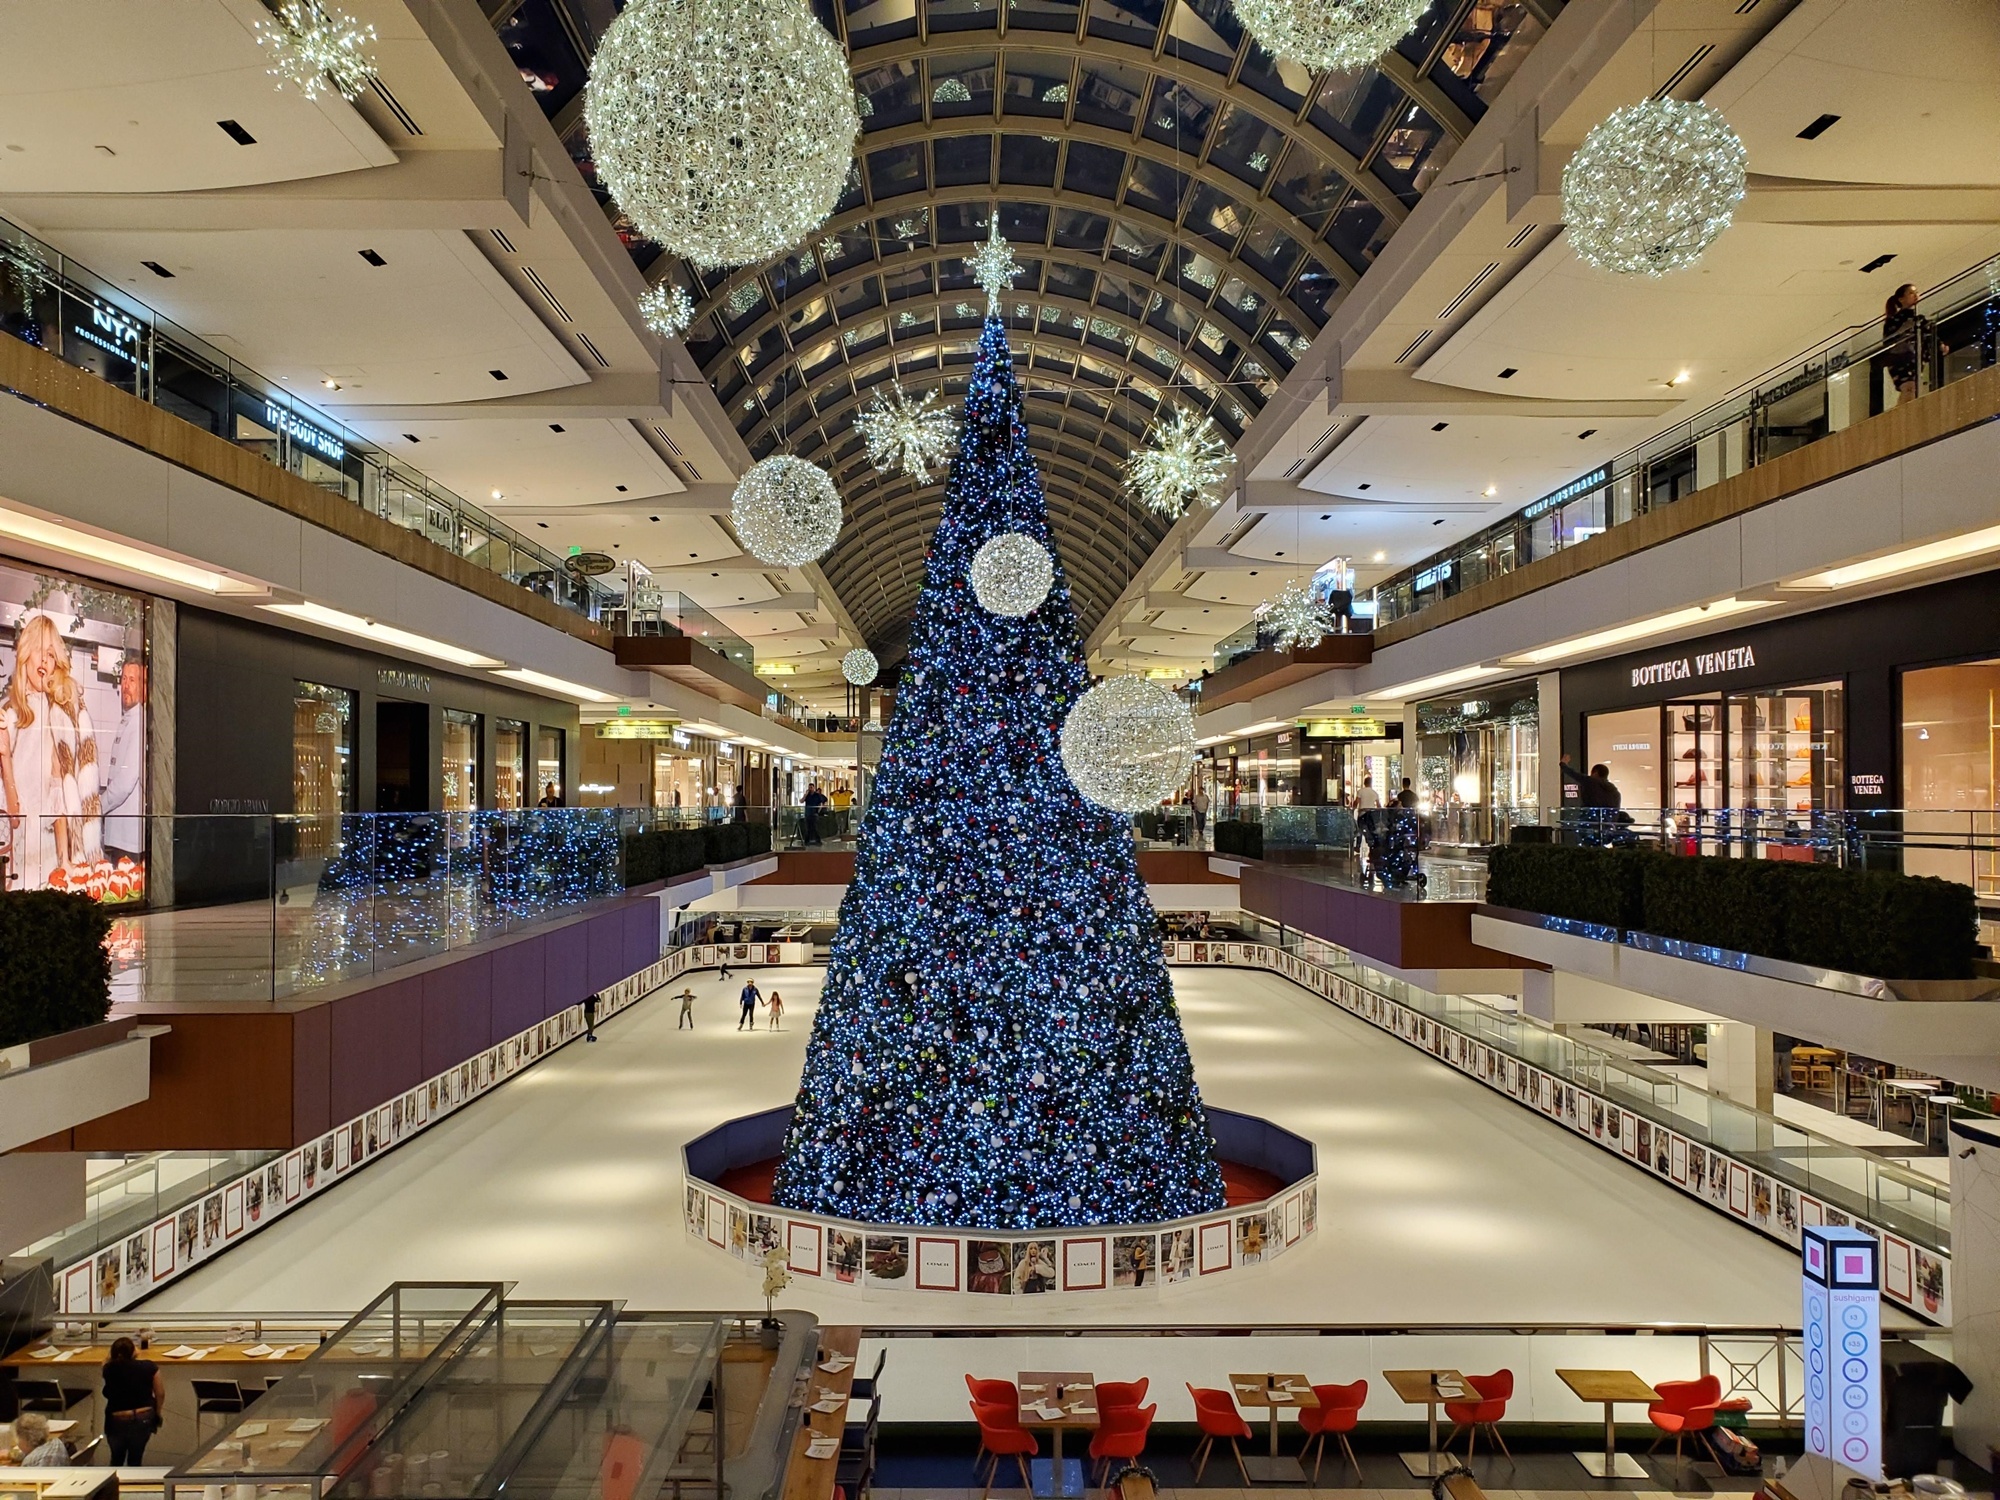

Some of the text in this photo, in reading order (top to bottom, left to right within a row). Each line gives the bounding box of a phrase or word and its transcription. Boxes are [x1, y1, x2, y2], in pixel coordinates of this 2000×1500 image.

[74, 325, 129, 360] PROFESSIONAL
[317, 430, 344, 461] SHOP
[1631, 645, 1756, 688] BOTTEGA VENETA
[1851, 774, 1885, 785] BOTTEGA
[1854, 785, 1882, 795] VENETA
[1833, 1293, 1876, 1303] sushigami
